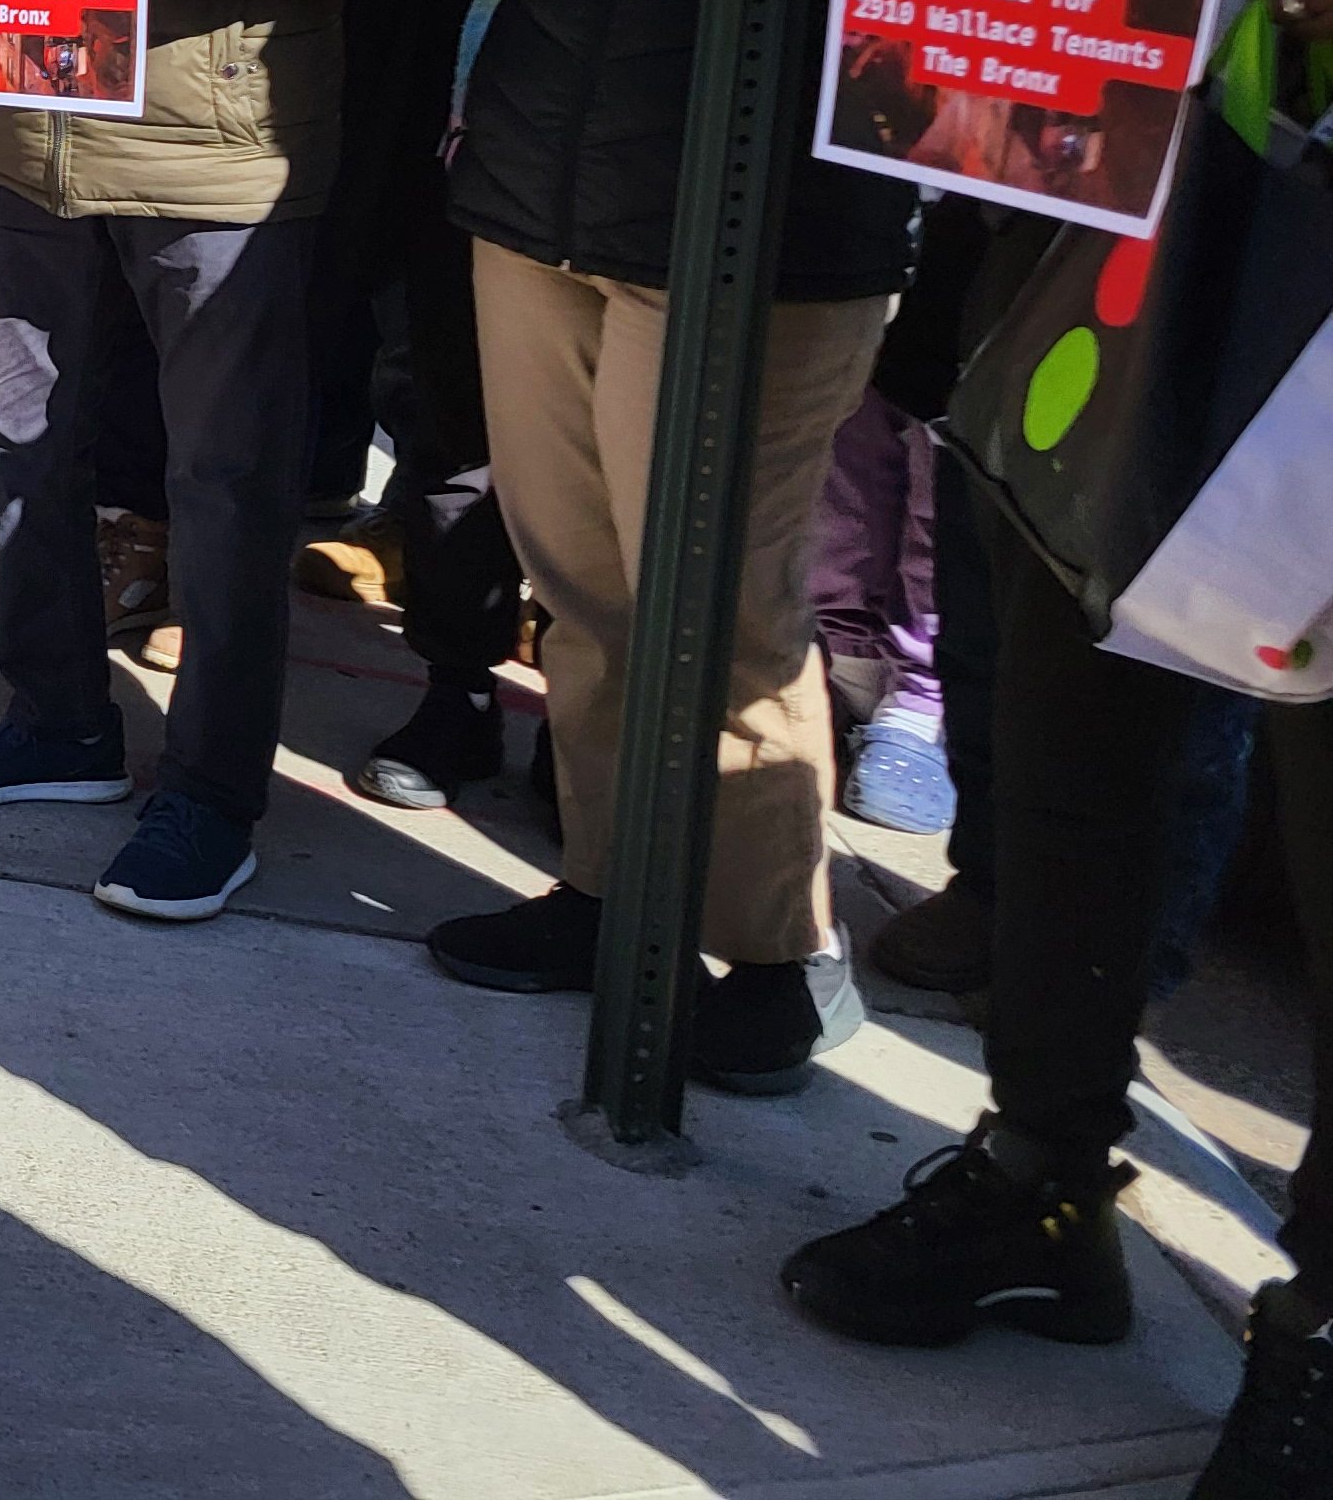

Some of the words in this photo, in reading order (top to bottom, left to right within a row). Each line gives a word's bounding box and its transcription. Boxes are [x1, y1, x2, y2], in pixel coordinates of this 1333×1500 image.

[0, 4, 51, 26] Bronx
[925, 5, 1037, 48] Wallace
[1050, 26, 1165, 70] Tenants
[922, 46, 969, 77] The
[980, 57, 1061, 96] Bronx
